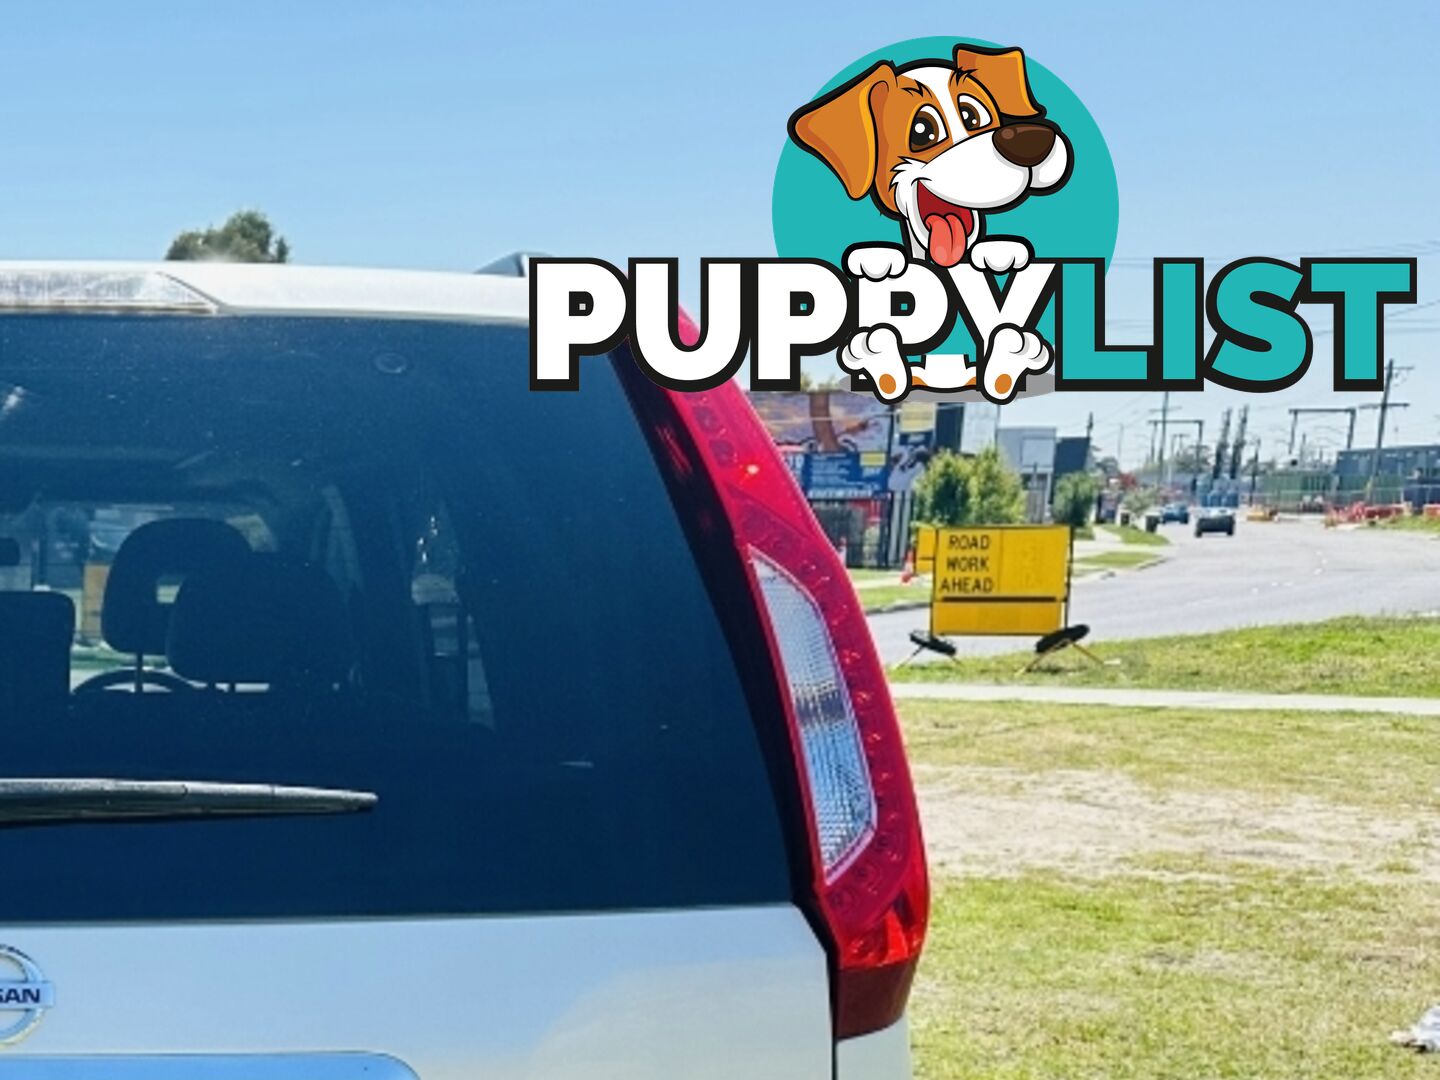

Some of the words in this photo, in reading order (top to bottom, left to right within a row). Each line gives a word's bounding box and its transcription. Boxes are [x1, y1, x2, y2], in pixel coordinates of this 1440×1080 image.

[949, 534, 990, 550] ROAD
[947, 556, 989, 571] WORK
[940, 576, 993, 593] AHEAD
